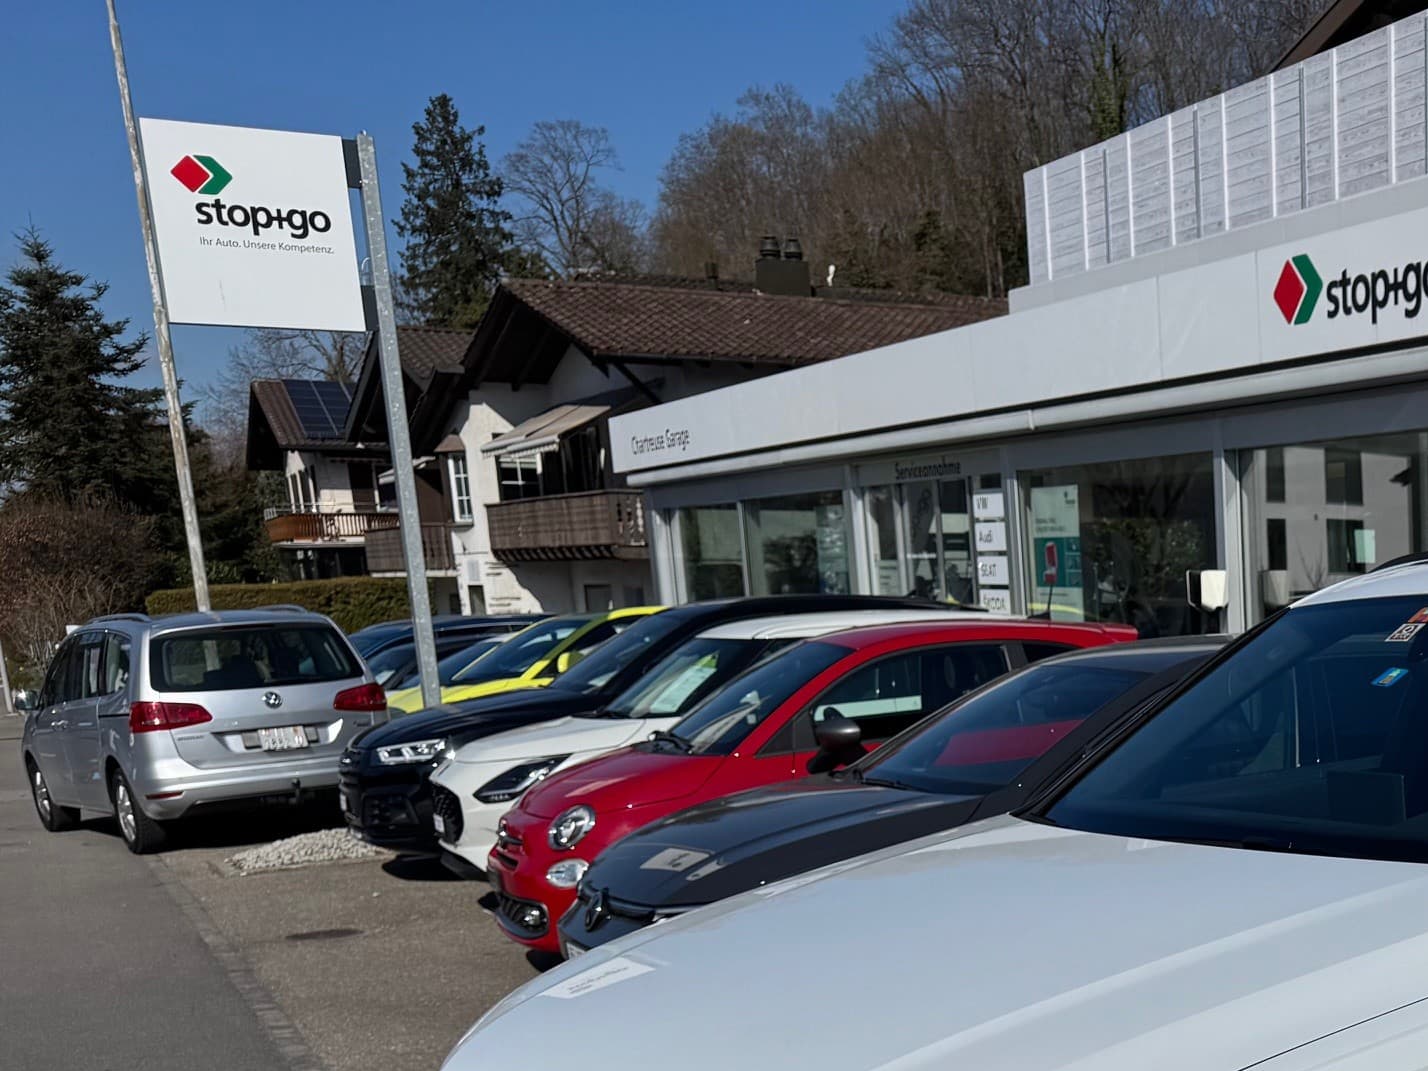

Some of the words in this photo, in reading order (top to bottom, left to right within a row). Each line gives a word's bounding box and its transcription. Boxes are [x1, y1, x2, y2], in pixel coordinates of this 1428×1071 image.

[195, 198, 331, 239] stop+go
[200, 237, 214, 246] Ihr
[215, 238, 242, 249] Auto.
[243, 240, 276, 251] Unsere
[278, 243, 335, 255] Kompetenz.
[665, 428, 691, 451] Garage
[895, 458, 961, 480] Serviceannahme
[979, 530, 993, 544] Audi
